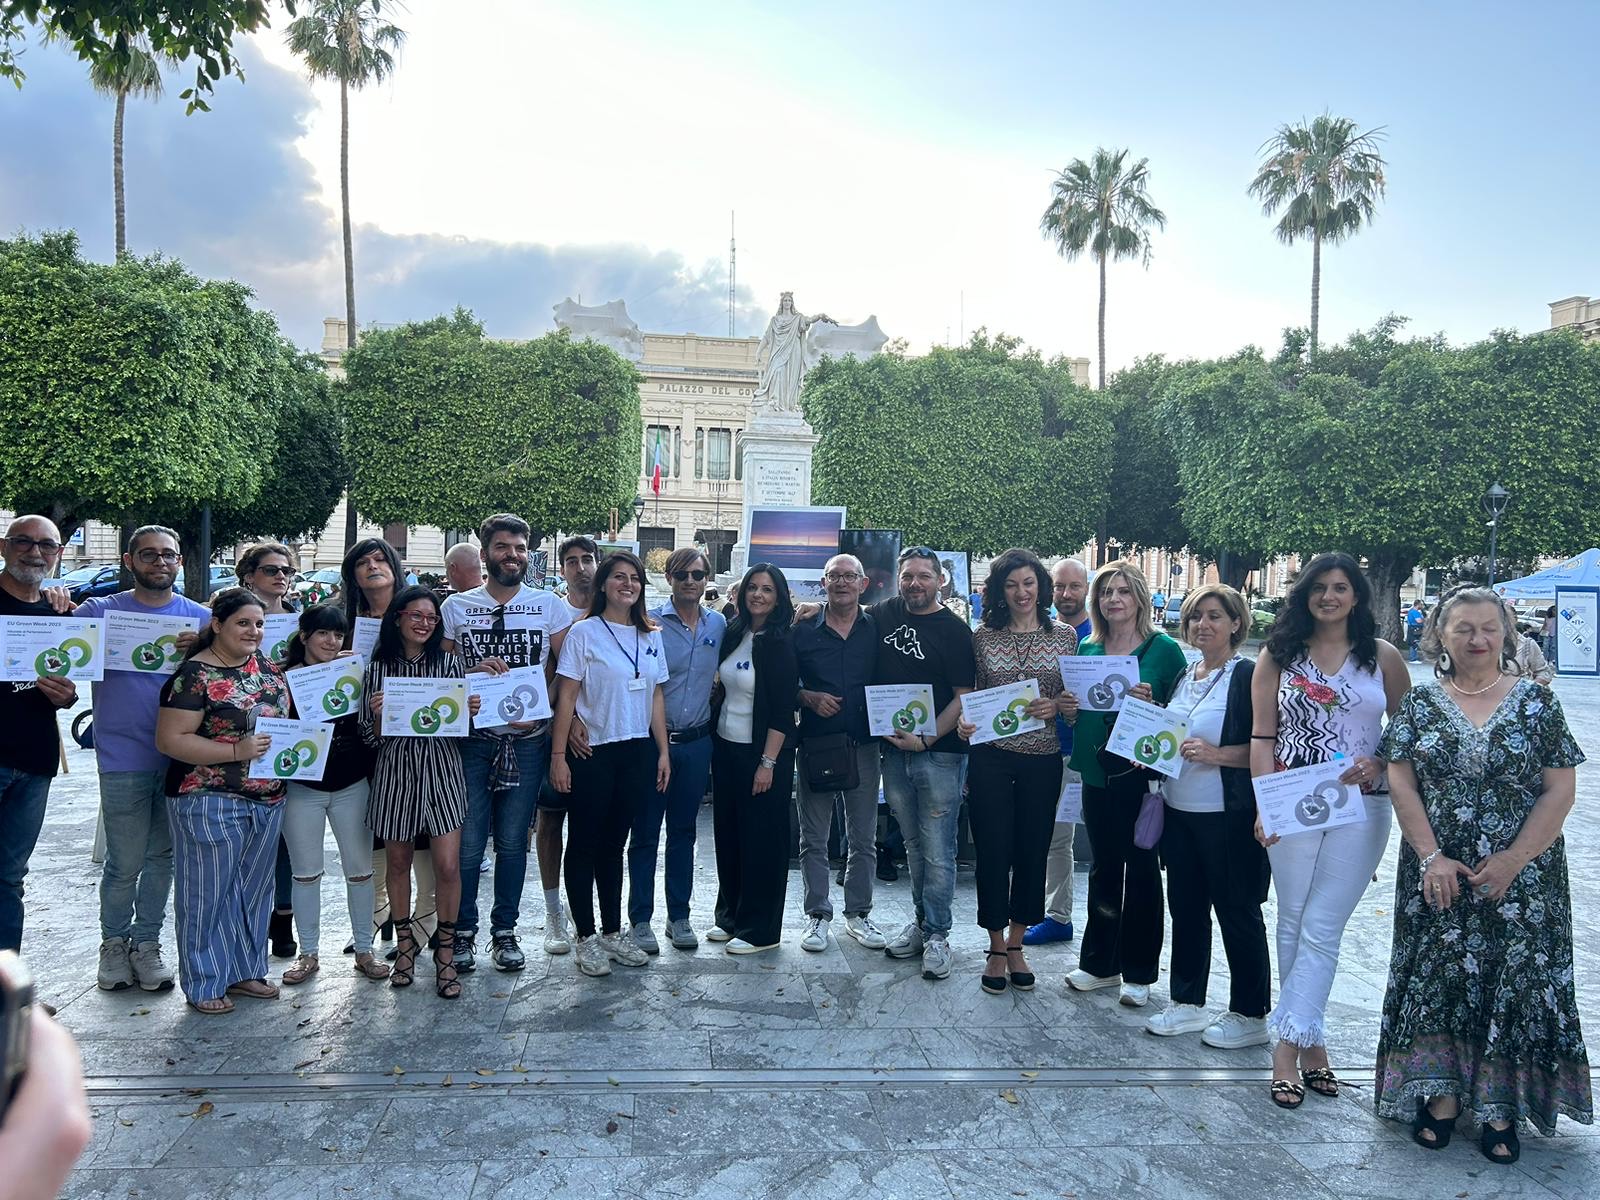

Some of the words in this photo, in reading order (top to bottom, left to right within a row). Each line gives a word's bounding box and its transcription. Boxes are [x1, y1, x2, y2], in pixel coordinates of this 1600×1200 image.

[658, 384, 704, 394] PALAZZO
[712, 387, 730, 395] DEL
[465, 644, 534, 658] DISTRICT
